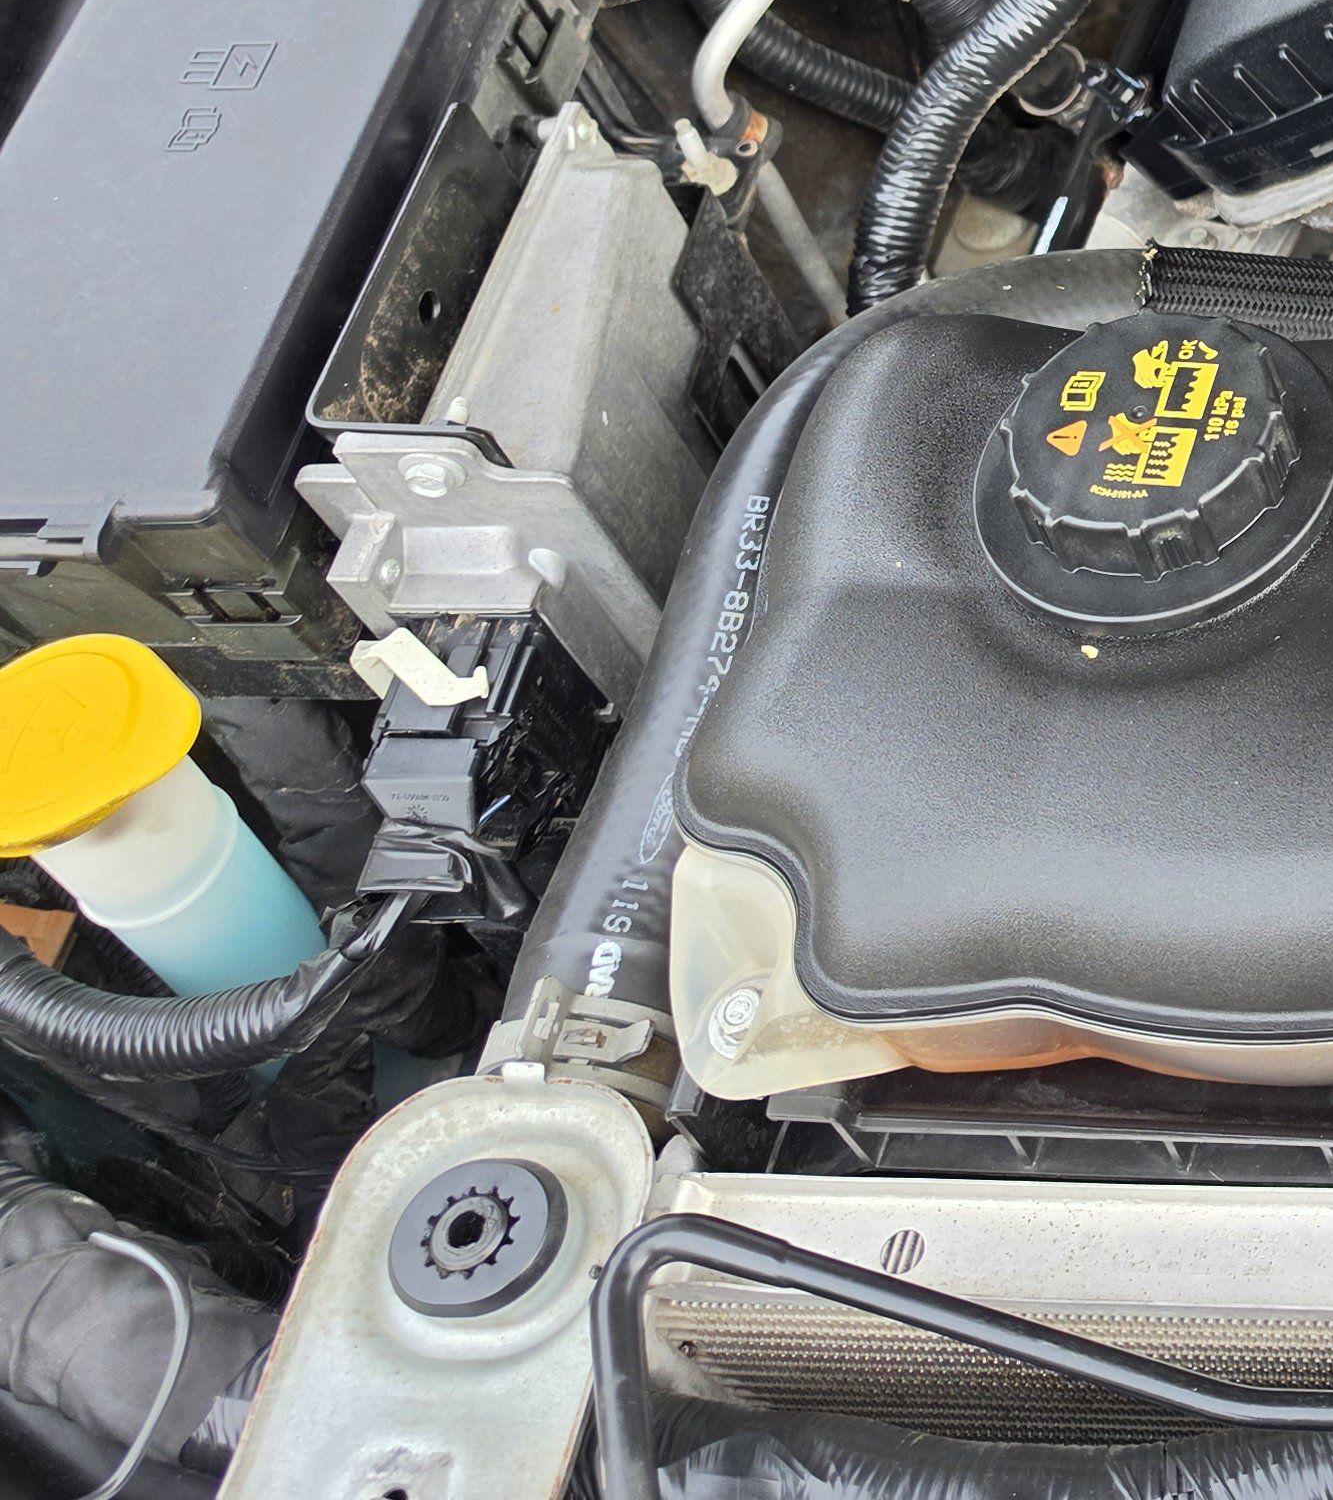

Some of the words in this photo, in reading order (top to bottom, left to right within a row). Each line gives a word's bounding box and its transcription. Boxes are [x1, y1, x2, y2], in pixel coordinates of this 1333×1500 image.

[1178, 339, 1198, 360] OK
[1211, 390, 1234, 415] kPa
[1230, 396, 1248, 419] psi
[1203, 416, 1225, 442] 110
